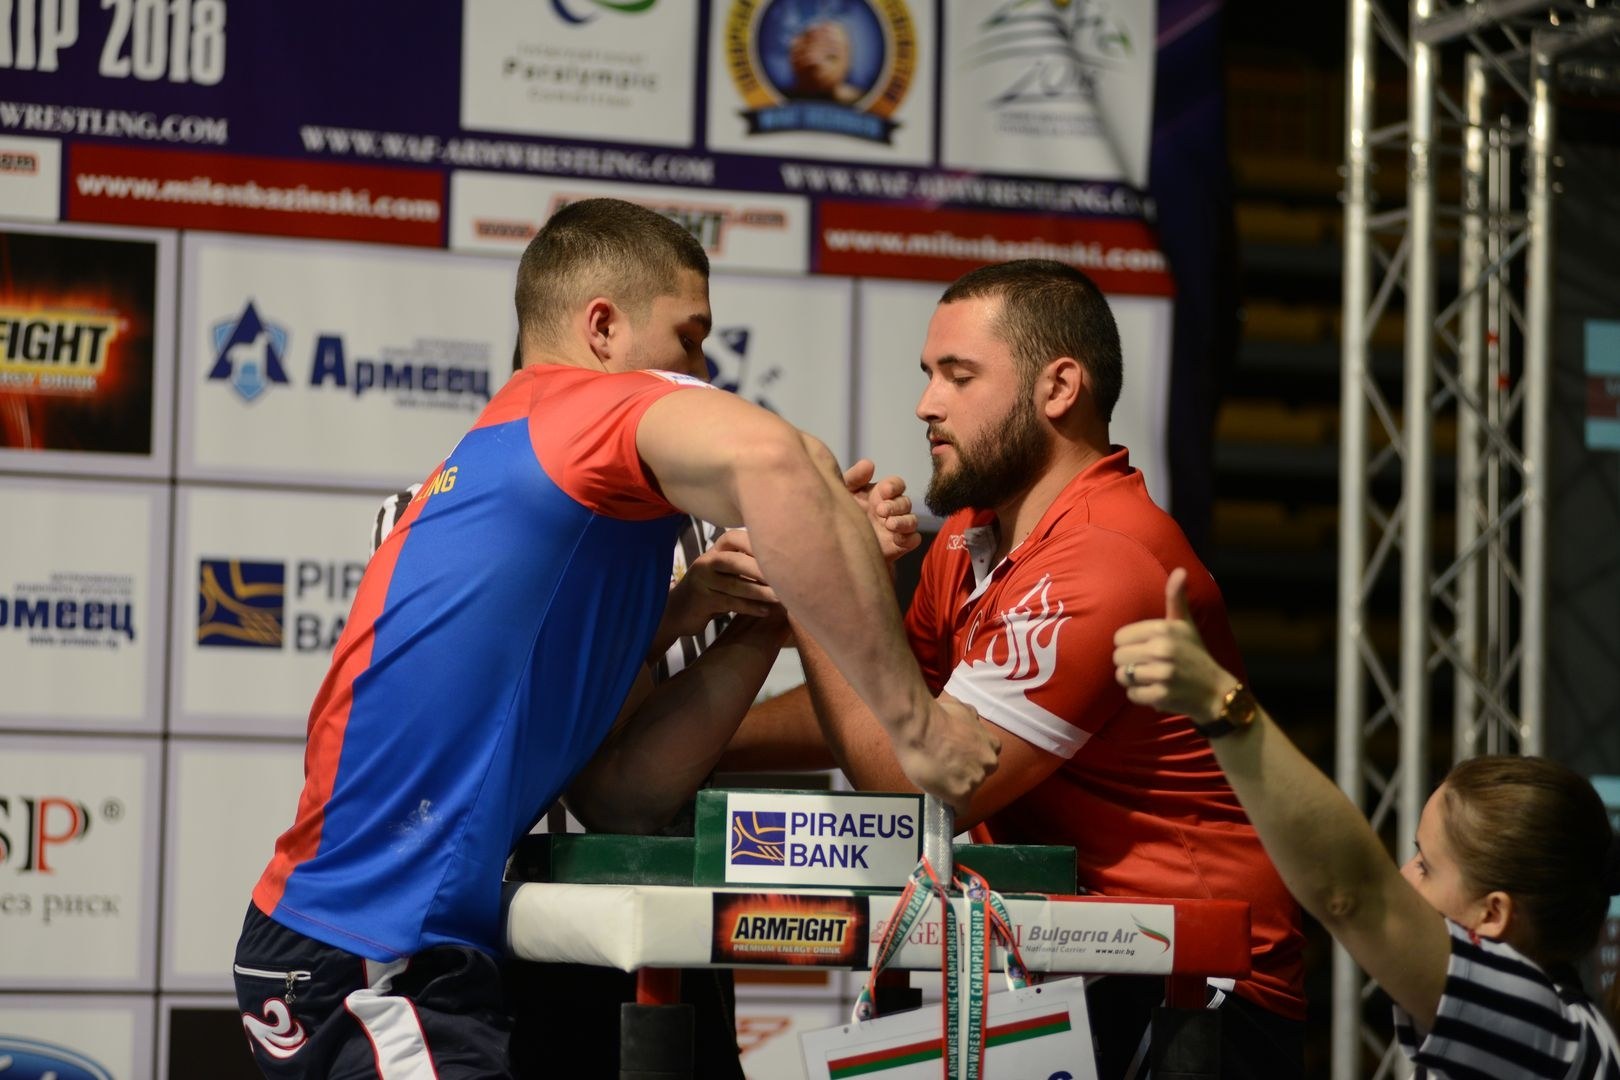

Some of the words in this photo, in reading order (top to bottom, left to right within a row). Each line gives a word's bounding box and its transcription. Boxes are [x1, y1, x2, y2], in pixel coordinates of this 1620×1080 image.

[99, 0, 226, 86] 2018
[76, 173, 441, 222] www.milenbazinski.com
[790, 812, 914, 839] PIRAEUS
[790, 843, 869, 869] BANK
[734, 916, 847, 942] ARMFIGHT
[1028, 926, 1109, 945] Bulgaria
[1111, 928, 1138, 943] Air
[733, 944, 775, 953] PREMIUM
[777, 945, 811, 953] ENERGY
[947, 912, 958, 994] CHAMPIONSHIP
[971, 910, 985, 996] CHAMPIONSHIP
[1061, 945, 1087, 954] Carrier
[1096, 948, 1136, 956] www.air.bg
[947, 997, 959, 1078] ARMWRESTLING
